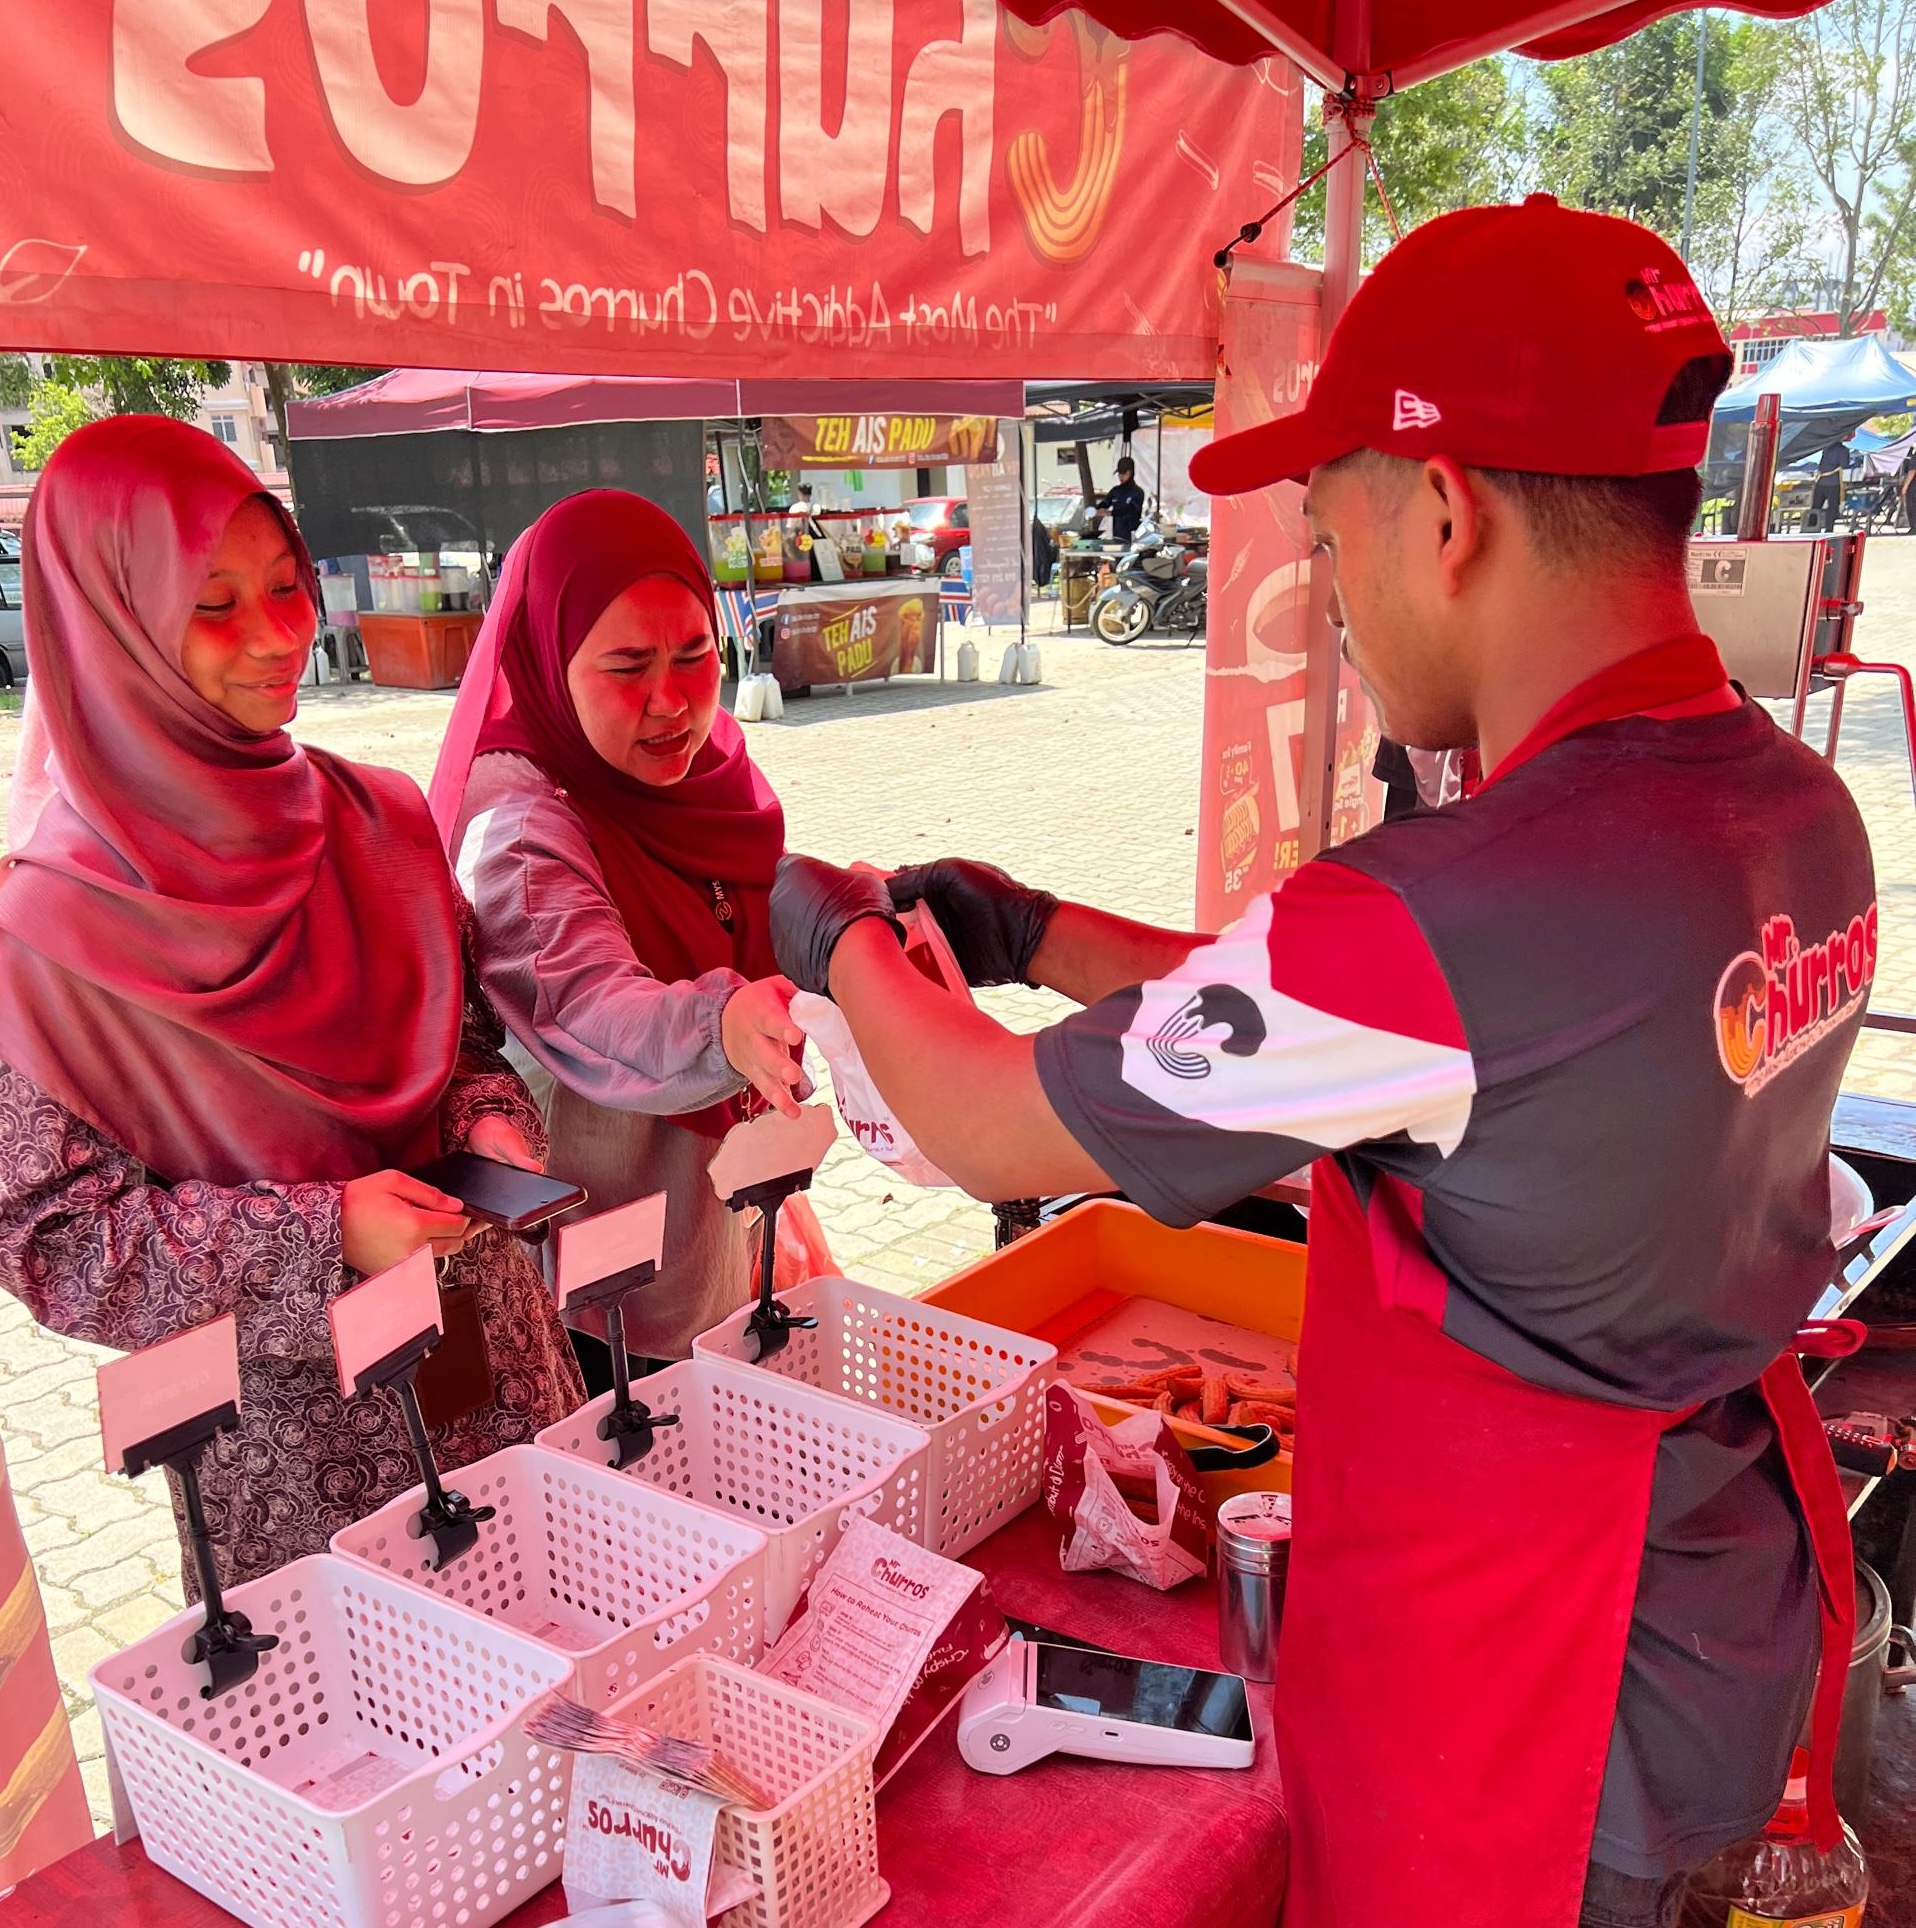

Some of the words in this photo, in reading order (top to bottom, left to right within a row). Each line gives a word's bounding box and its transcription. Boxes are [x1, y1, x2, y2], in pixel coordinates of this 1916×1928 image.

[815, 417, 851, 453] TEH
[852, 416, 887, 454] AIS
[888, 417, 937, 452] PADU
[823, 620, 849, 652] TEH
[850, 605, 878, 642] AIS
[836, 638, 873, 677] PADU
[1714, 901, 1877, 1084] Churros
[871, 1558, 930, 1599] Churros
[831, 1588, 847, 1600] How
[847, 1596, 856, 1604] to
[856, 1600, 882, 1619] Reheat
[882, 1613, 899, 1627] Your
[588, 1800, 691, 1882] Churros
[653, 1860, 669, 1879] Mr
